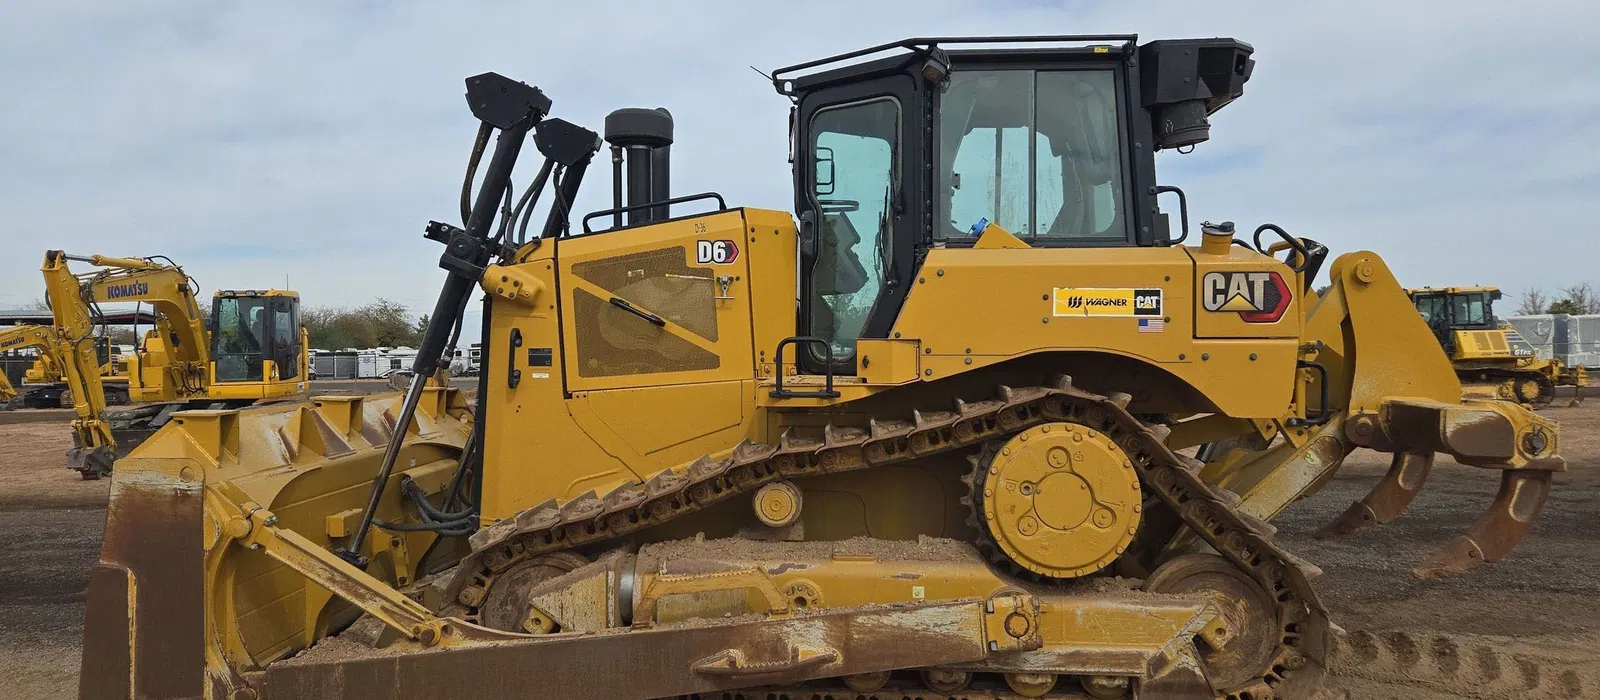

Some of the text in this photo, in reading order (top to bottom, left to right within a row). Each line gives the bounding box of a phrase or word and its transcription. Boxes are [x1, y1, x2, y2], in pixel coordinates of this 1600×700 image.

[697, 240, 726, 263] D6
[107, 280, 148, 299] KOMATSU
[1203, 272, 1271, 311] CAT
[1085, 295, 1159, 309] WAGNER CAT
